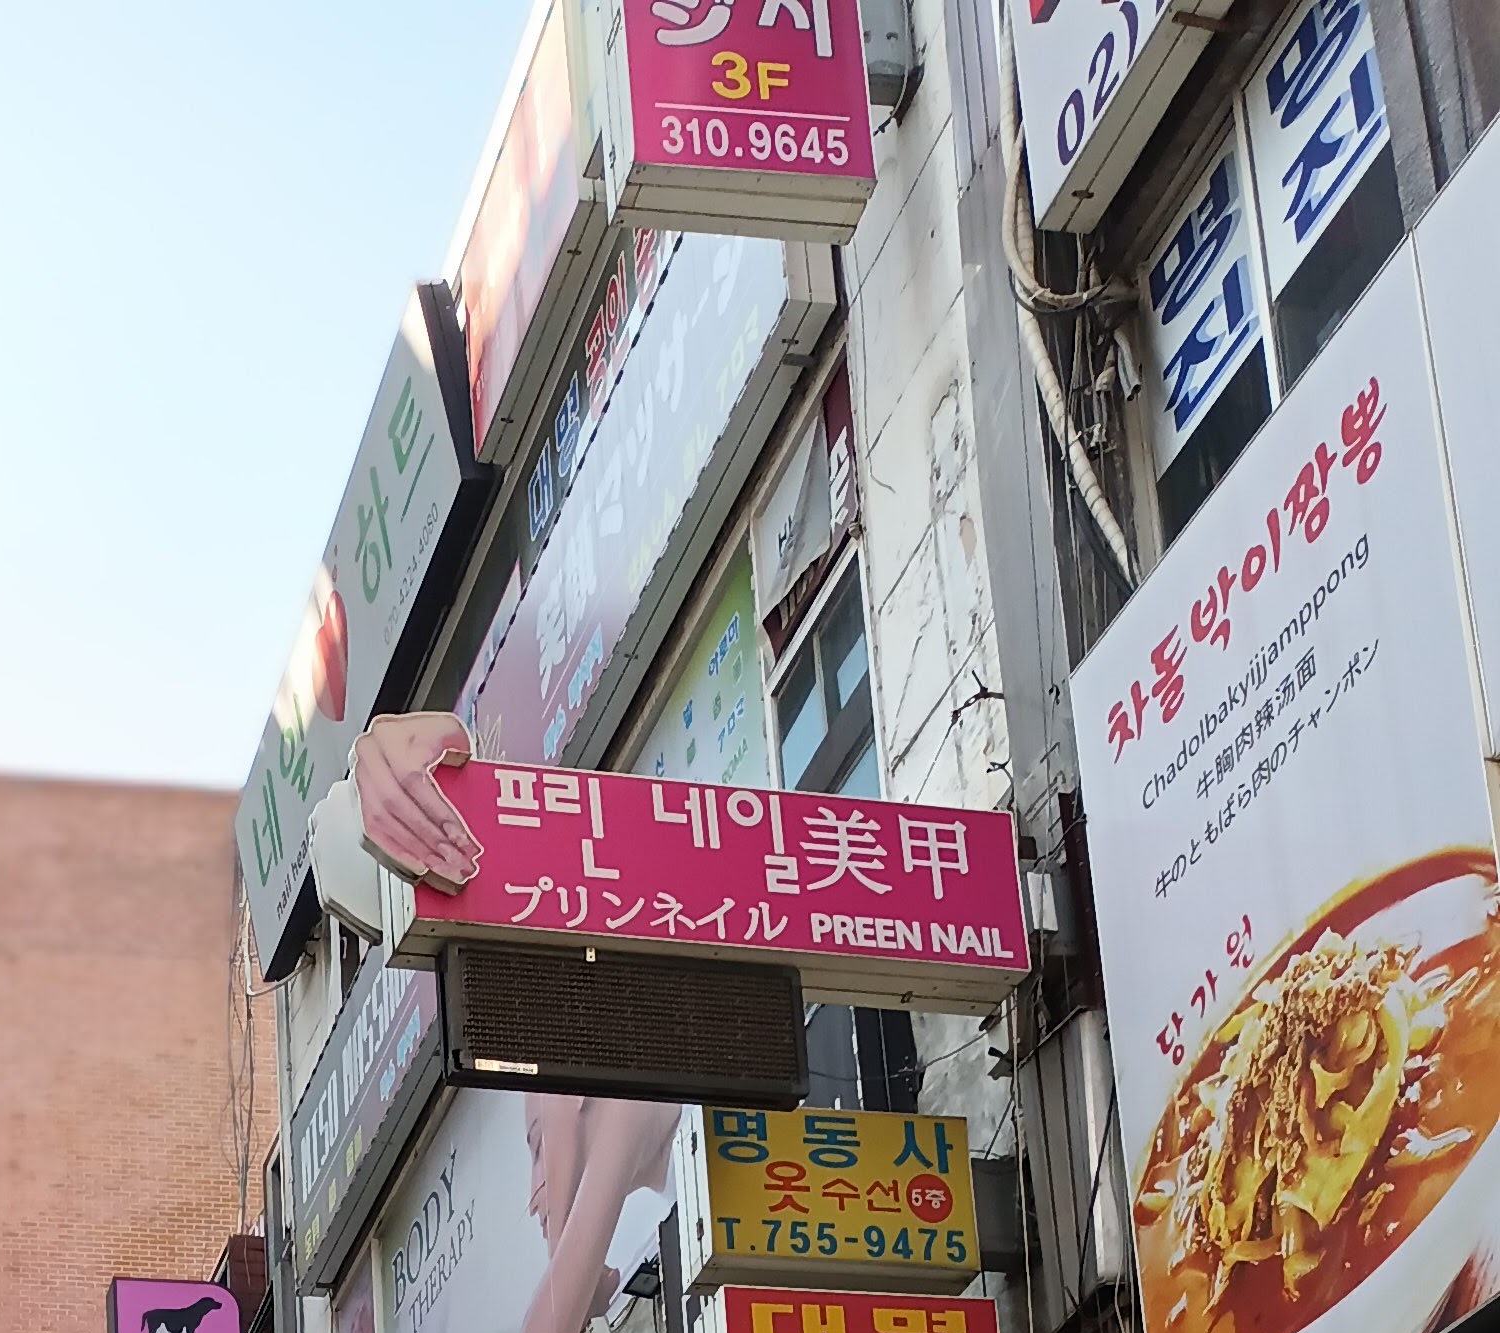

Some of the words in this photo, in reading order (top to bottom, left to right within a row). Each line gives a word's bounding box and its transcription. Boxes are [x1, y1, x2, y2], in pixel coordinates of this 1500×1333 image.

[711, 51, 790, 100] 3F
[661, 116, 850, 166] 310.9645
[1148, 150, 1263, 433] 명진
[1141, 532, 1371, 810] Chadolbakyijjamppong
[497, 769, 620, 881] 프린
[653, 787, 802, 896] 네일
[799, 806, 972, 902] 美甲
[503, 880, 789, 943] プリンネイル
[810, 912, 924, 952] PREEN
[931, 920, 1015, 961] NAIL
[300, 1068, 339, 1204] MISO
[711, 1109, 956, 1176] 명동사
[910, 1187, 948, 1210] 5층
[392, 1147, 458, 1319] BODY
[717, 1216, 969, 1265] T.755-9475
